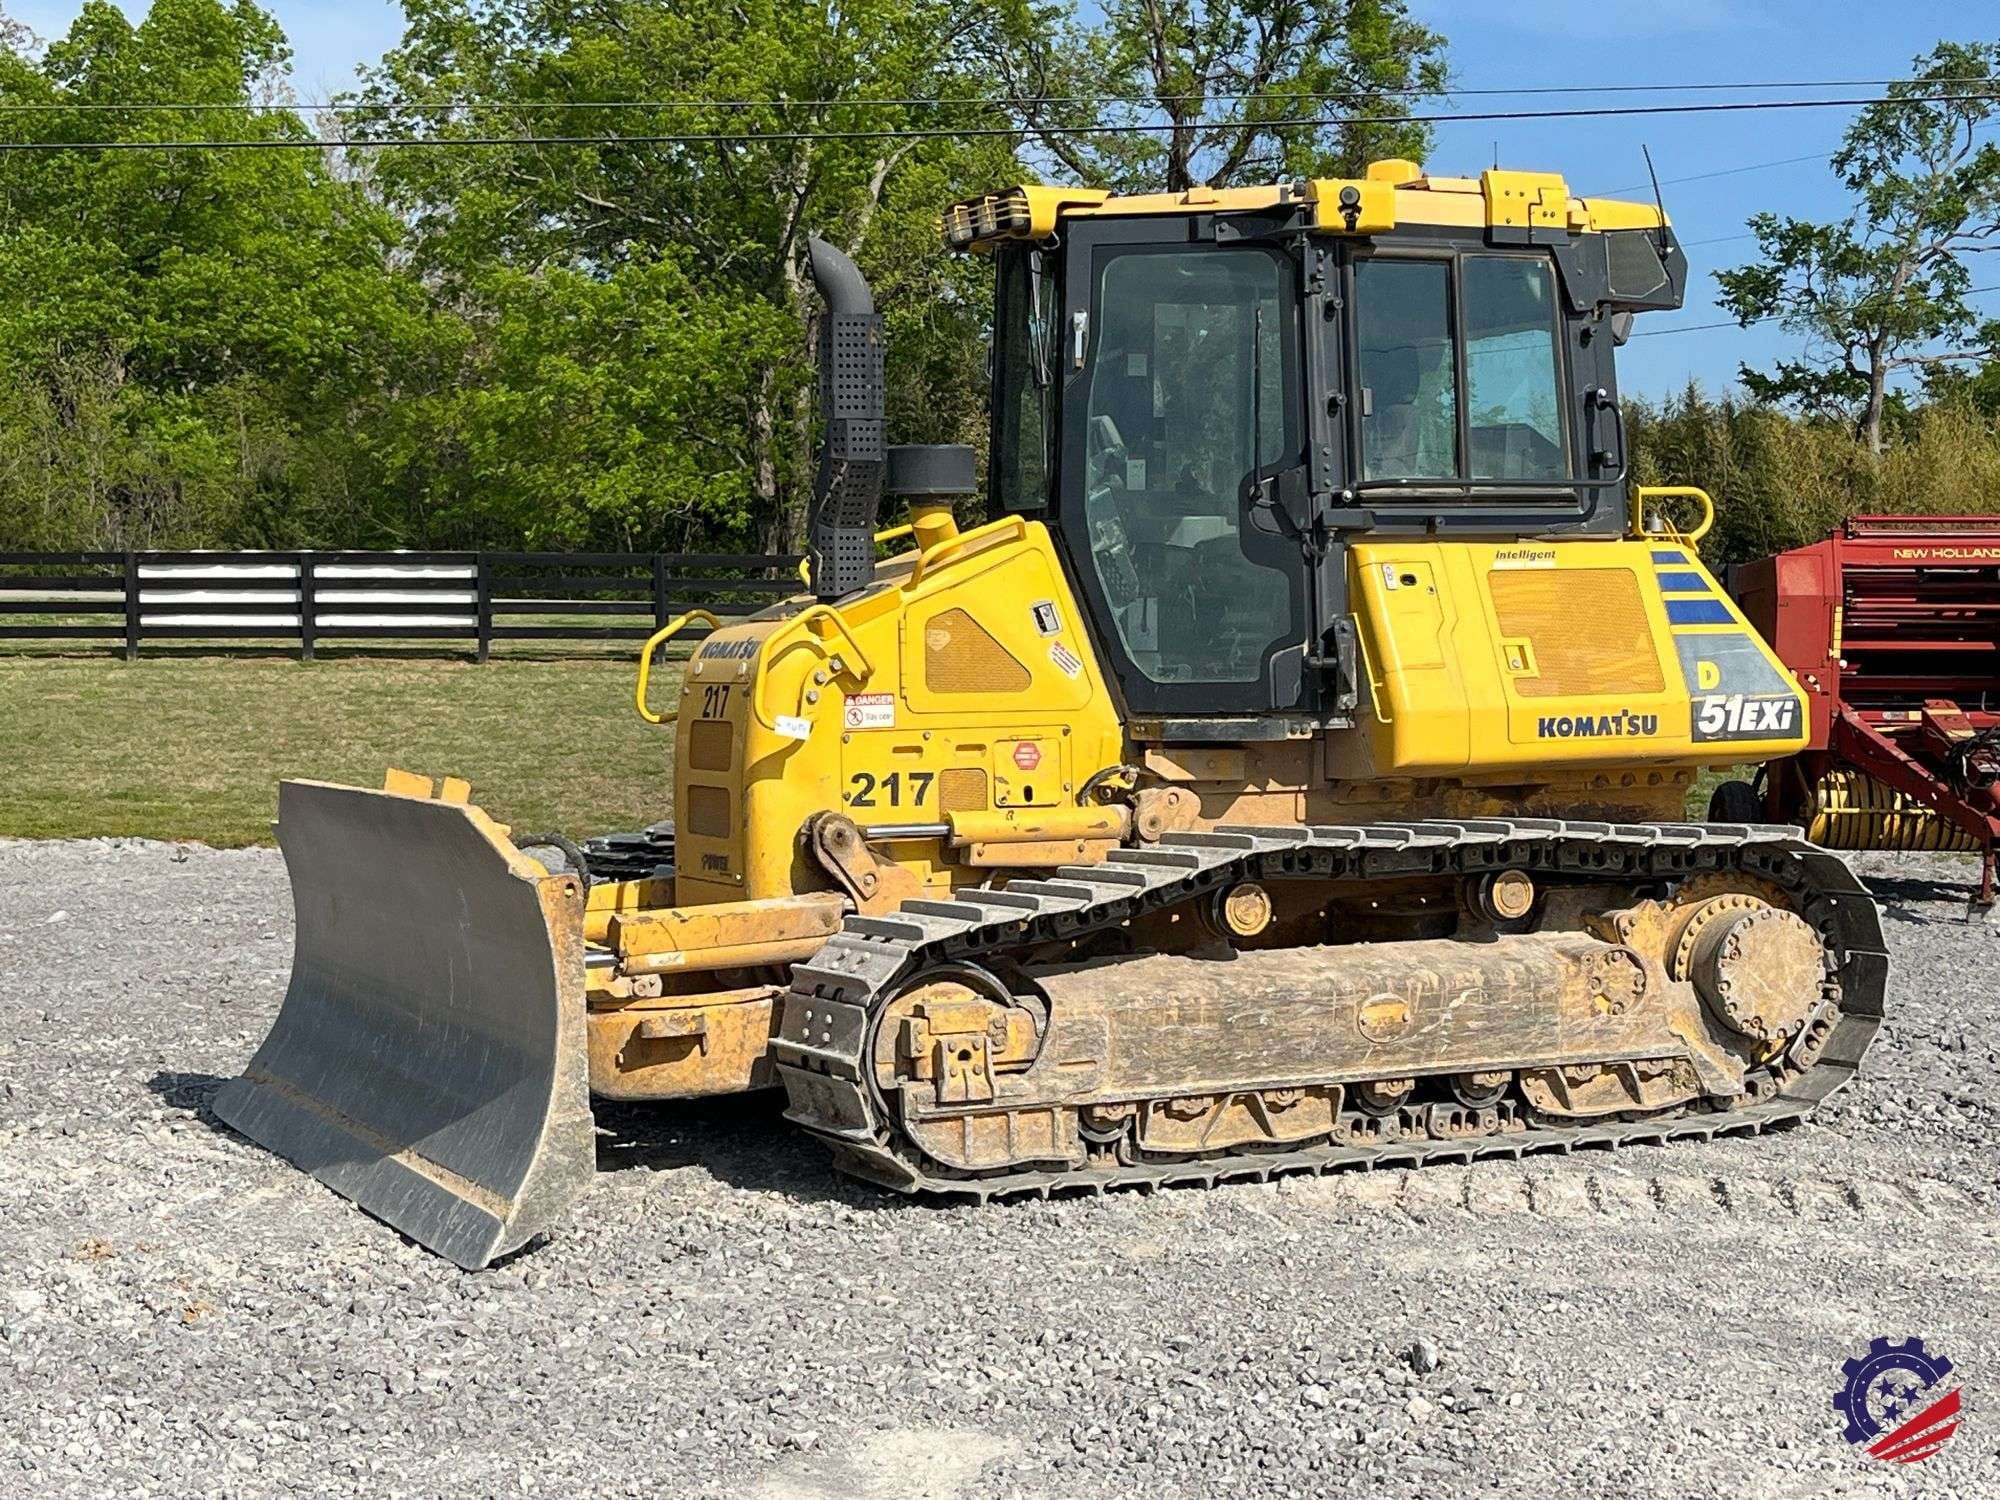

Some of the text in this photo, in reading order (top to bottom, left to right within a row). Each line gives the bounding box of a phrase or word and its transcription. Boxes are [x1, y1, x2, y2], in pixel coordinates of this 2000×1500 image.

[1893, 548, 2000, 559] NEW HOLLAND
[699, 636, 760, 659] KOMATSU
[1697, 661, 1720, 690] D
[702, 685, 730, 718] 217
[855, 695, 894, 705] DANGER
[1538, 709, 1658, 737] KOMATSU
[850, 772, 934, 806] 217
